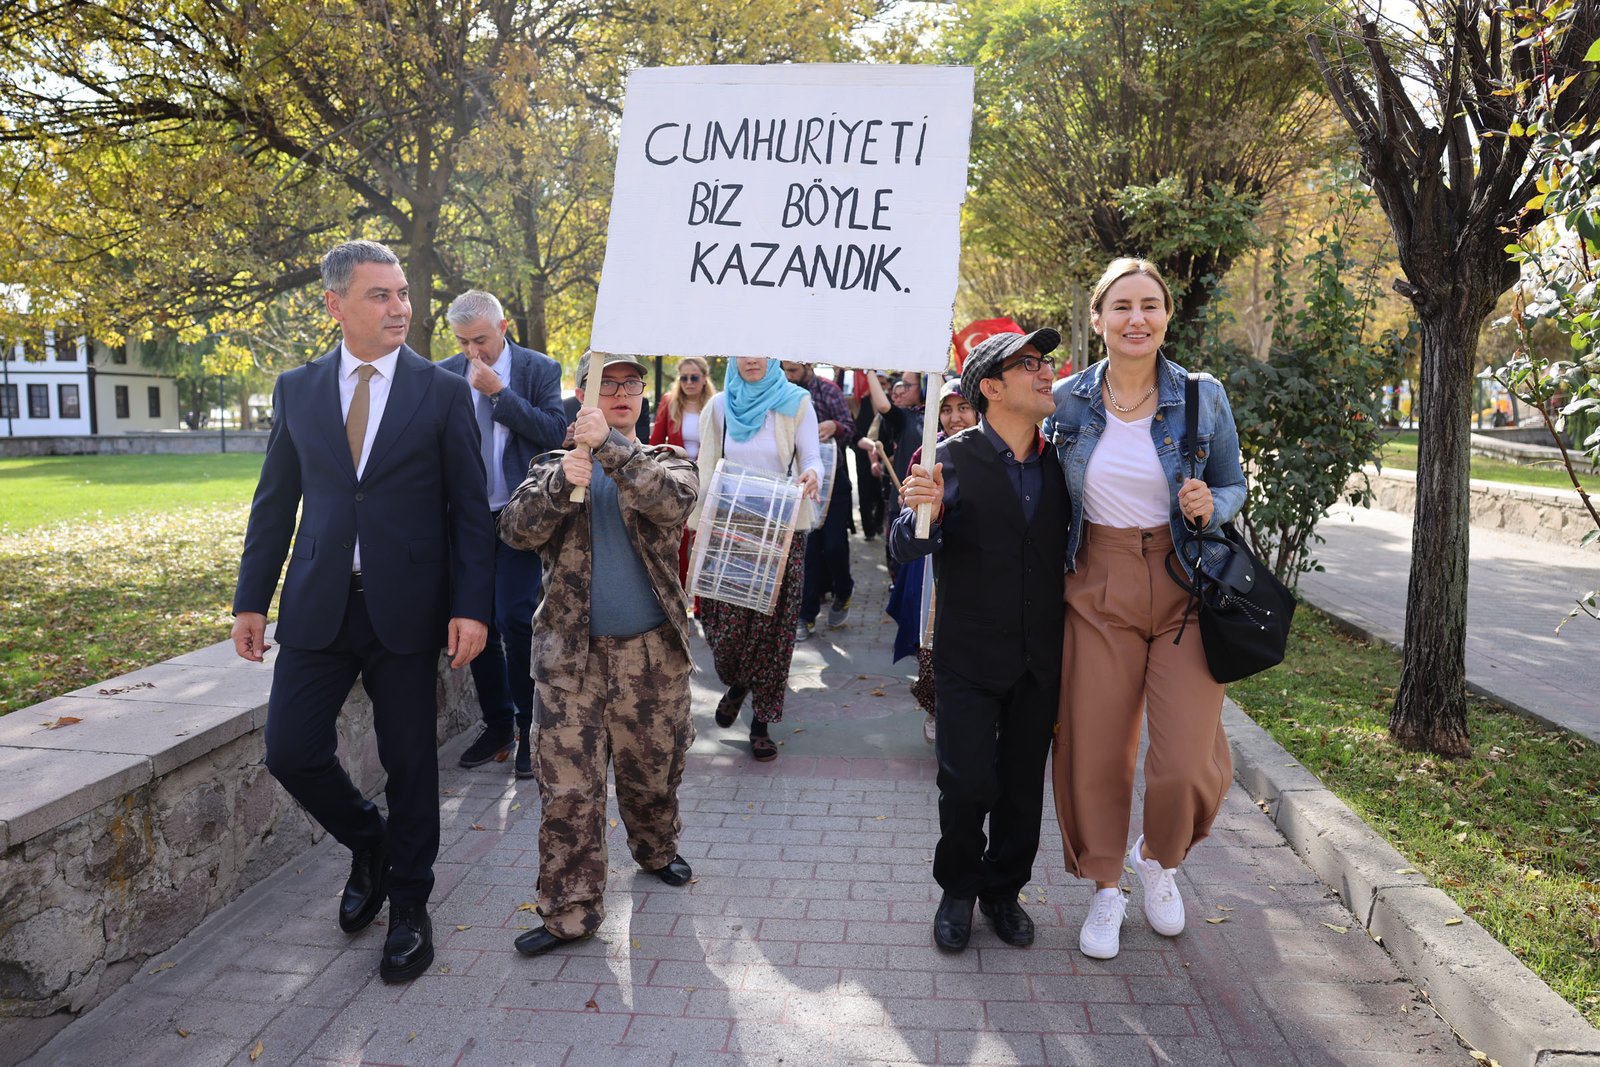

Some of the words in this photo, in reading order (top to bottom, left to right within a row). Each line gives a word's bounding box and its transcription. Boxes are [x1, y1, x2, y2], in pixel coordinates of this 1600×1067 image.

[645, 111, 928, 166] CUMHURİYETİ
[688, 178, 744, 226] BİZ
[781, 178, 893, 230] BÖYLE
[690, 240, 911, 294] KAZANDIK.
